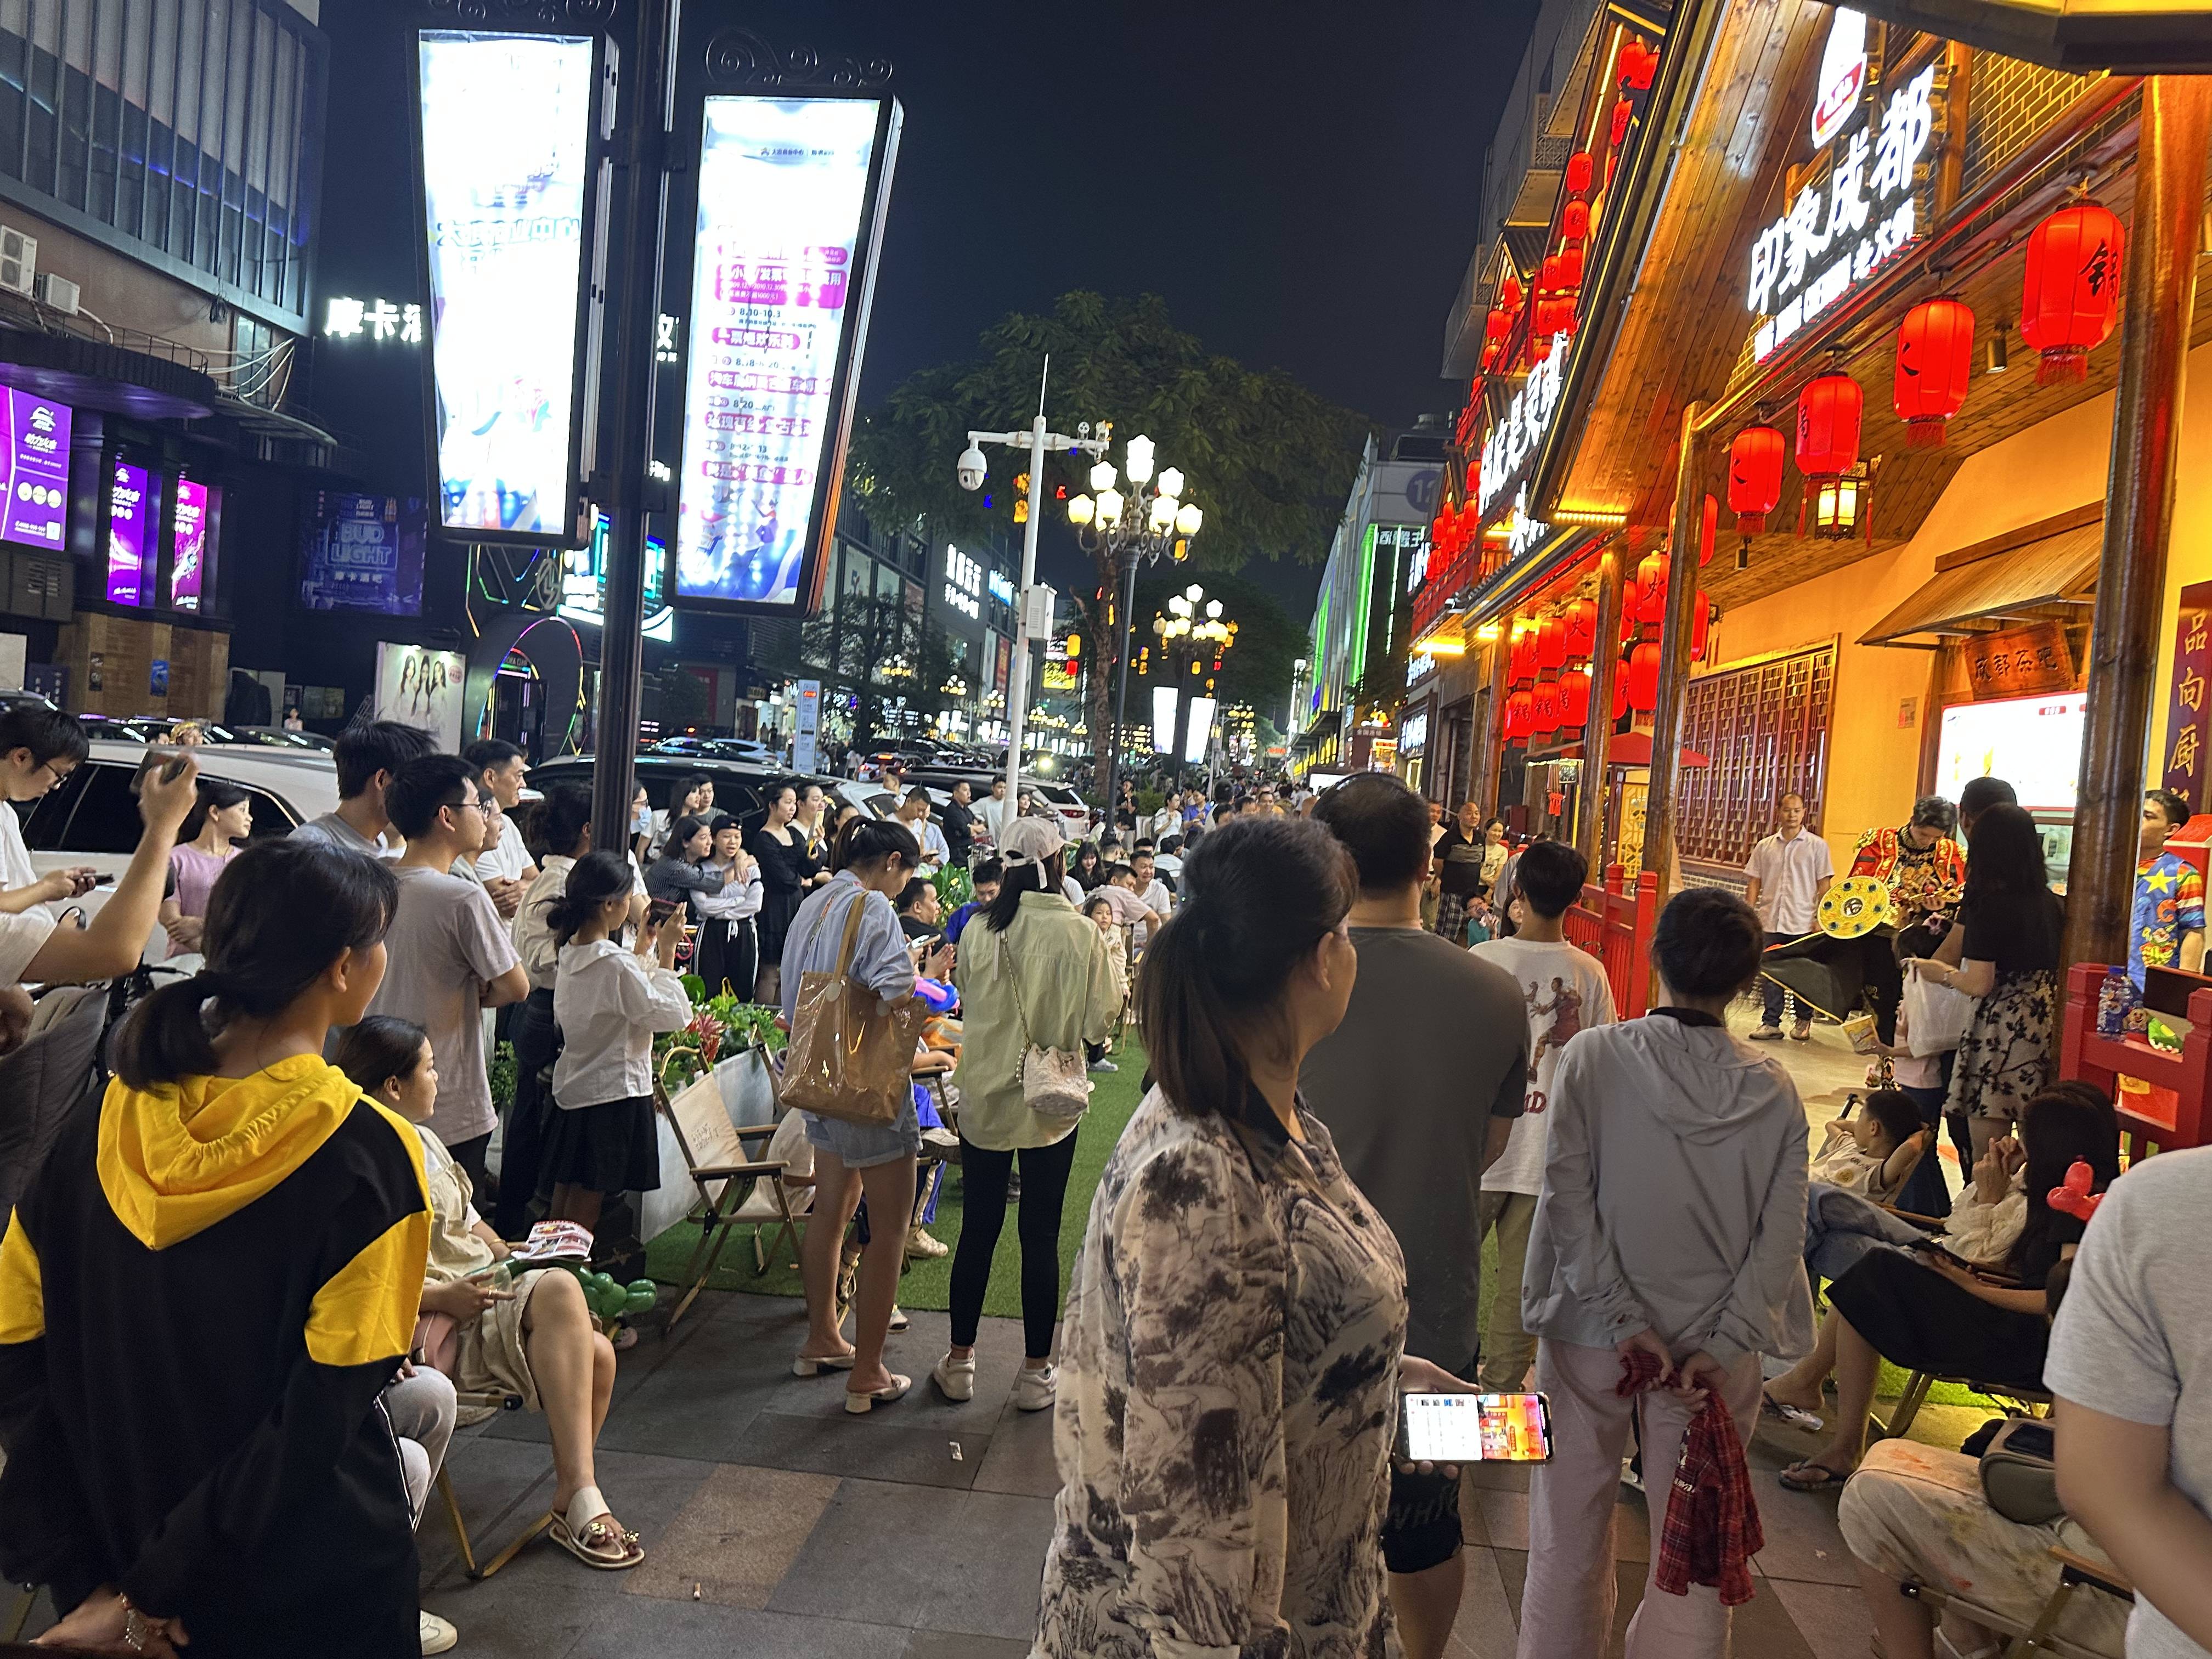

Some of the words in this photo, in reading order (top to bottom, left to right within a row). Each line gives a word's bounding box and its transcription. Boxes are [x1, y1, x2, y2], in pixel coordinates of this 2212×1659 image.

[1748, 64, 1934, 315] 印象成都
[341, 522, 385, 544] BUD
[331, 543, 392, 566] LIGHT
[1568, 612, 1590, 638] 火
